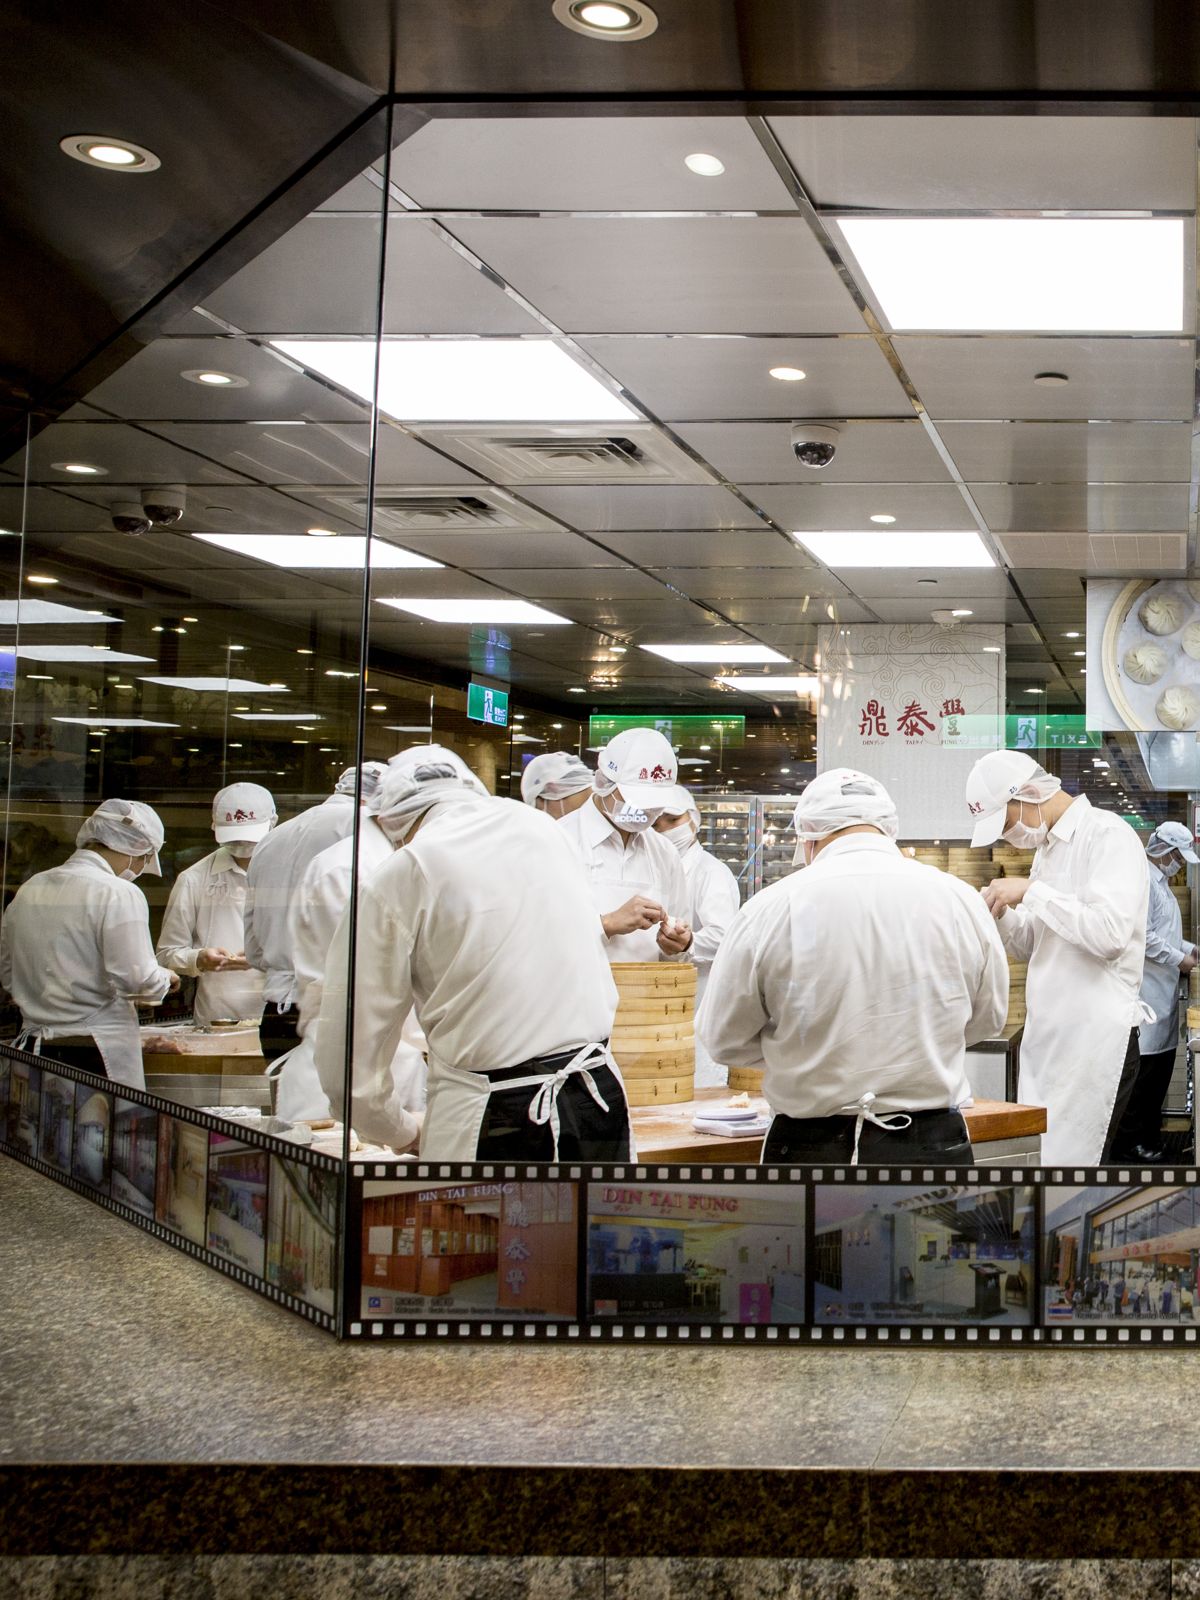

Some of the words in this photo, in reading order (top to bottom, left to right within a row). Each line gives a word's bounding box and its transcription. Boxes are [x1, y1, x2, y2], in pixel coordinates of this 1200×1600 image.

[858, 699, 966, 737] 鼎泰豐
[418, 1190, 438, 1202] DIN
[446, 1187, 465, 1200] TAI
[473, 1183, 514, 1197] FUNG
[602, 1187, 642, 1205] DIN
[648, 1191, 682, 1208] TAI
[687, 1195, 739, 1212] FUNG
